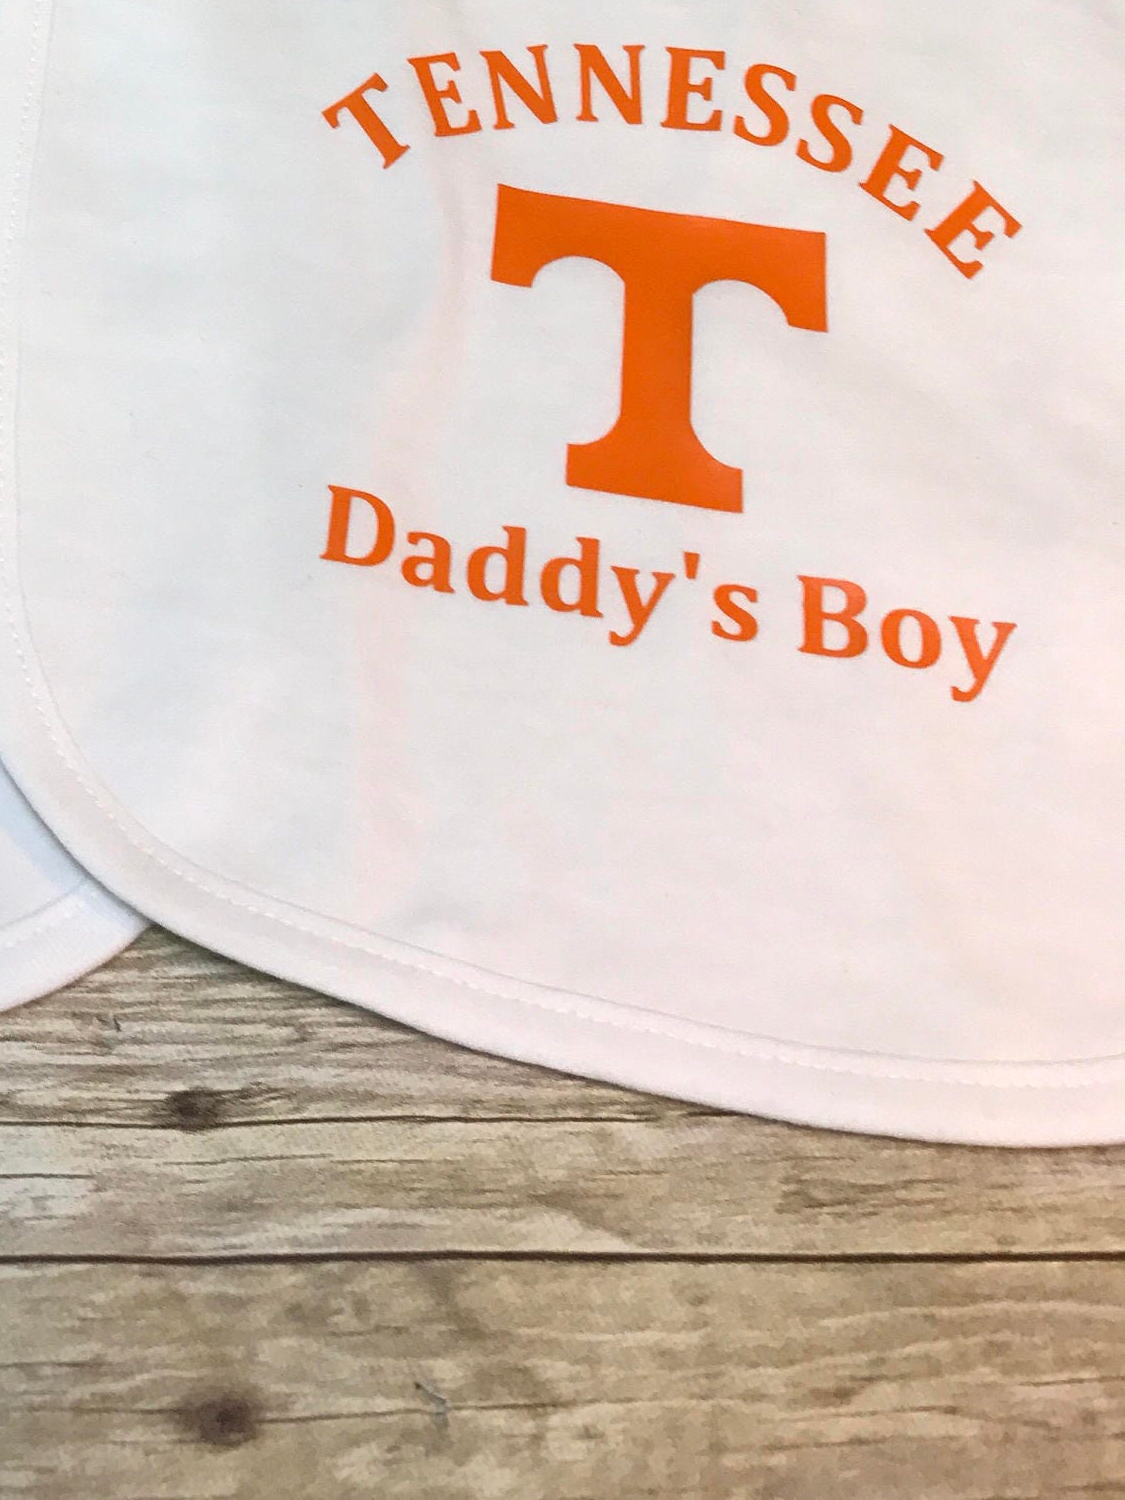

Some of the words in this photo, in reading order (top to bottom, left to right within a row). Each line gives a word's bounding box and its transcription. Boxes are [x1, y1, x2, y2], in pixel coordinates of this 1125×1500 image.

[321, 43, 1023, 280] TENNESSEE
[490, 182, 829, 514] T
[319, 484, 759, 647] Daddy's
[797, 574, 1017, 703] Boy
